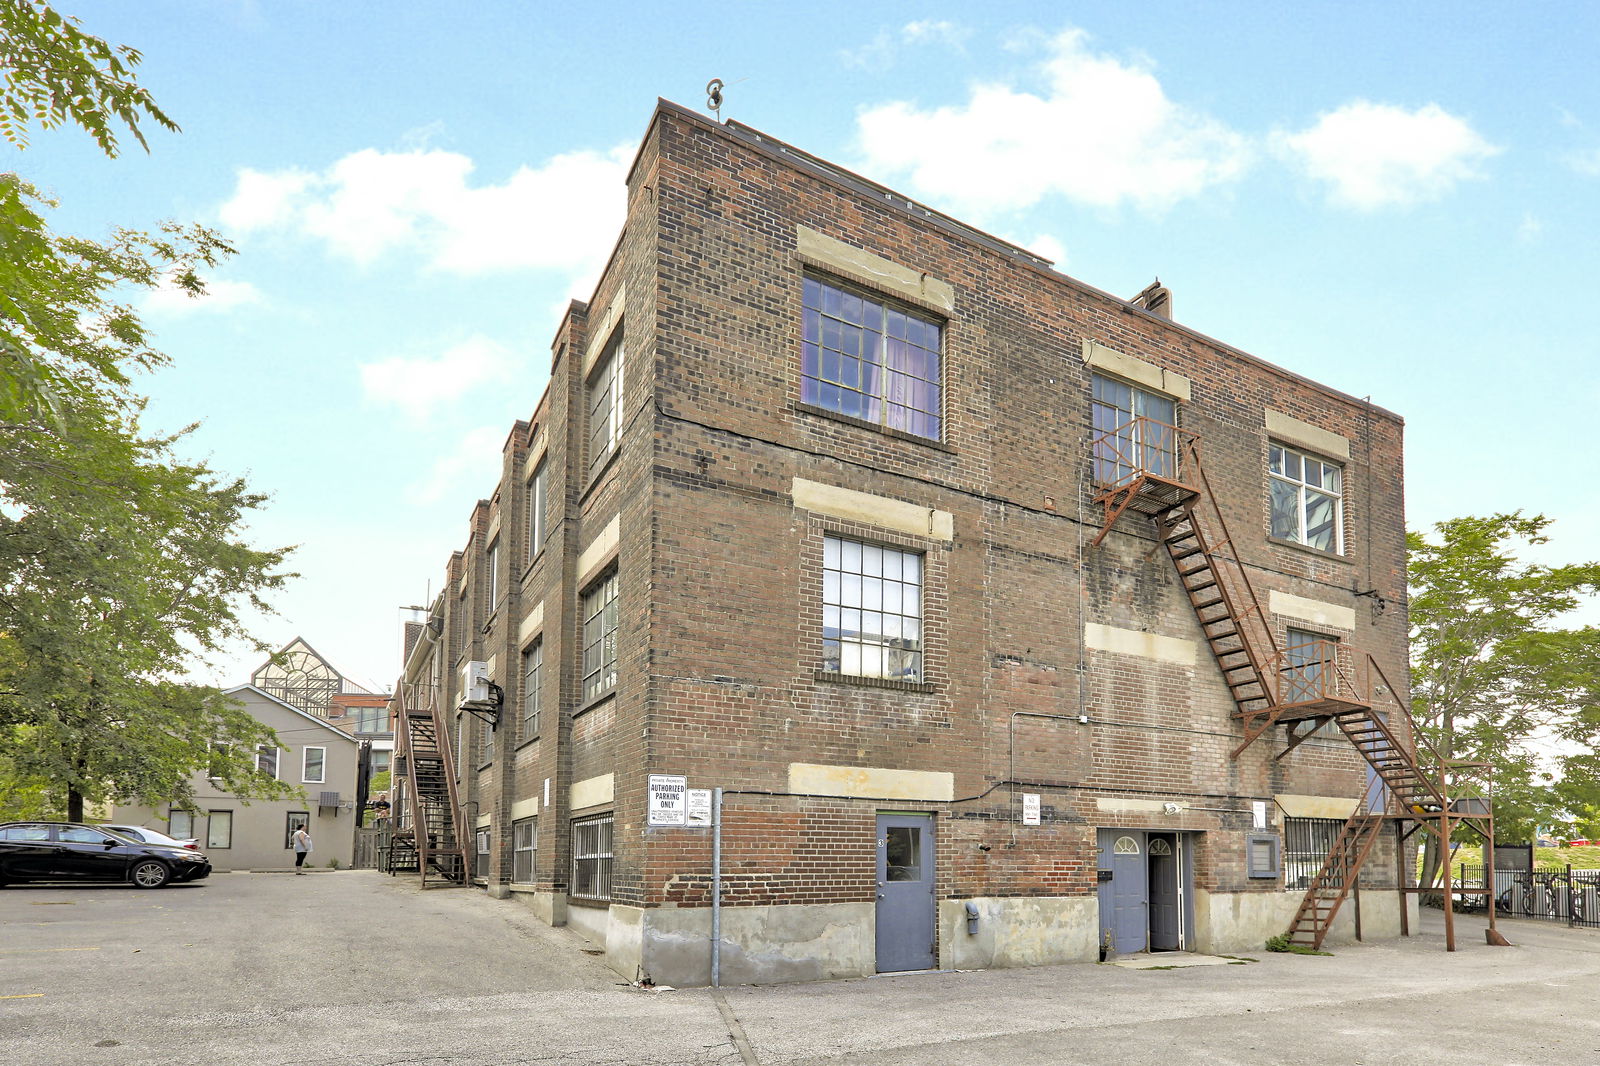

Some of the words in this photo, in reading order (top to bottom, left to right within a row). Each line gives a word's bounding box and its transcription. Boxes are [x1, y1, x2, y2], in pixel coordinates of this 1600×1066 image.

[650, 784, 684, 792] AUTHORIZED
[656, 792, 680, 800] PARKING
[660, 800, 674, 808] ONLY
